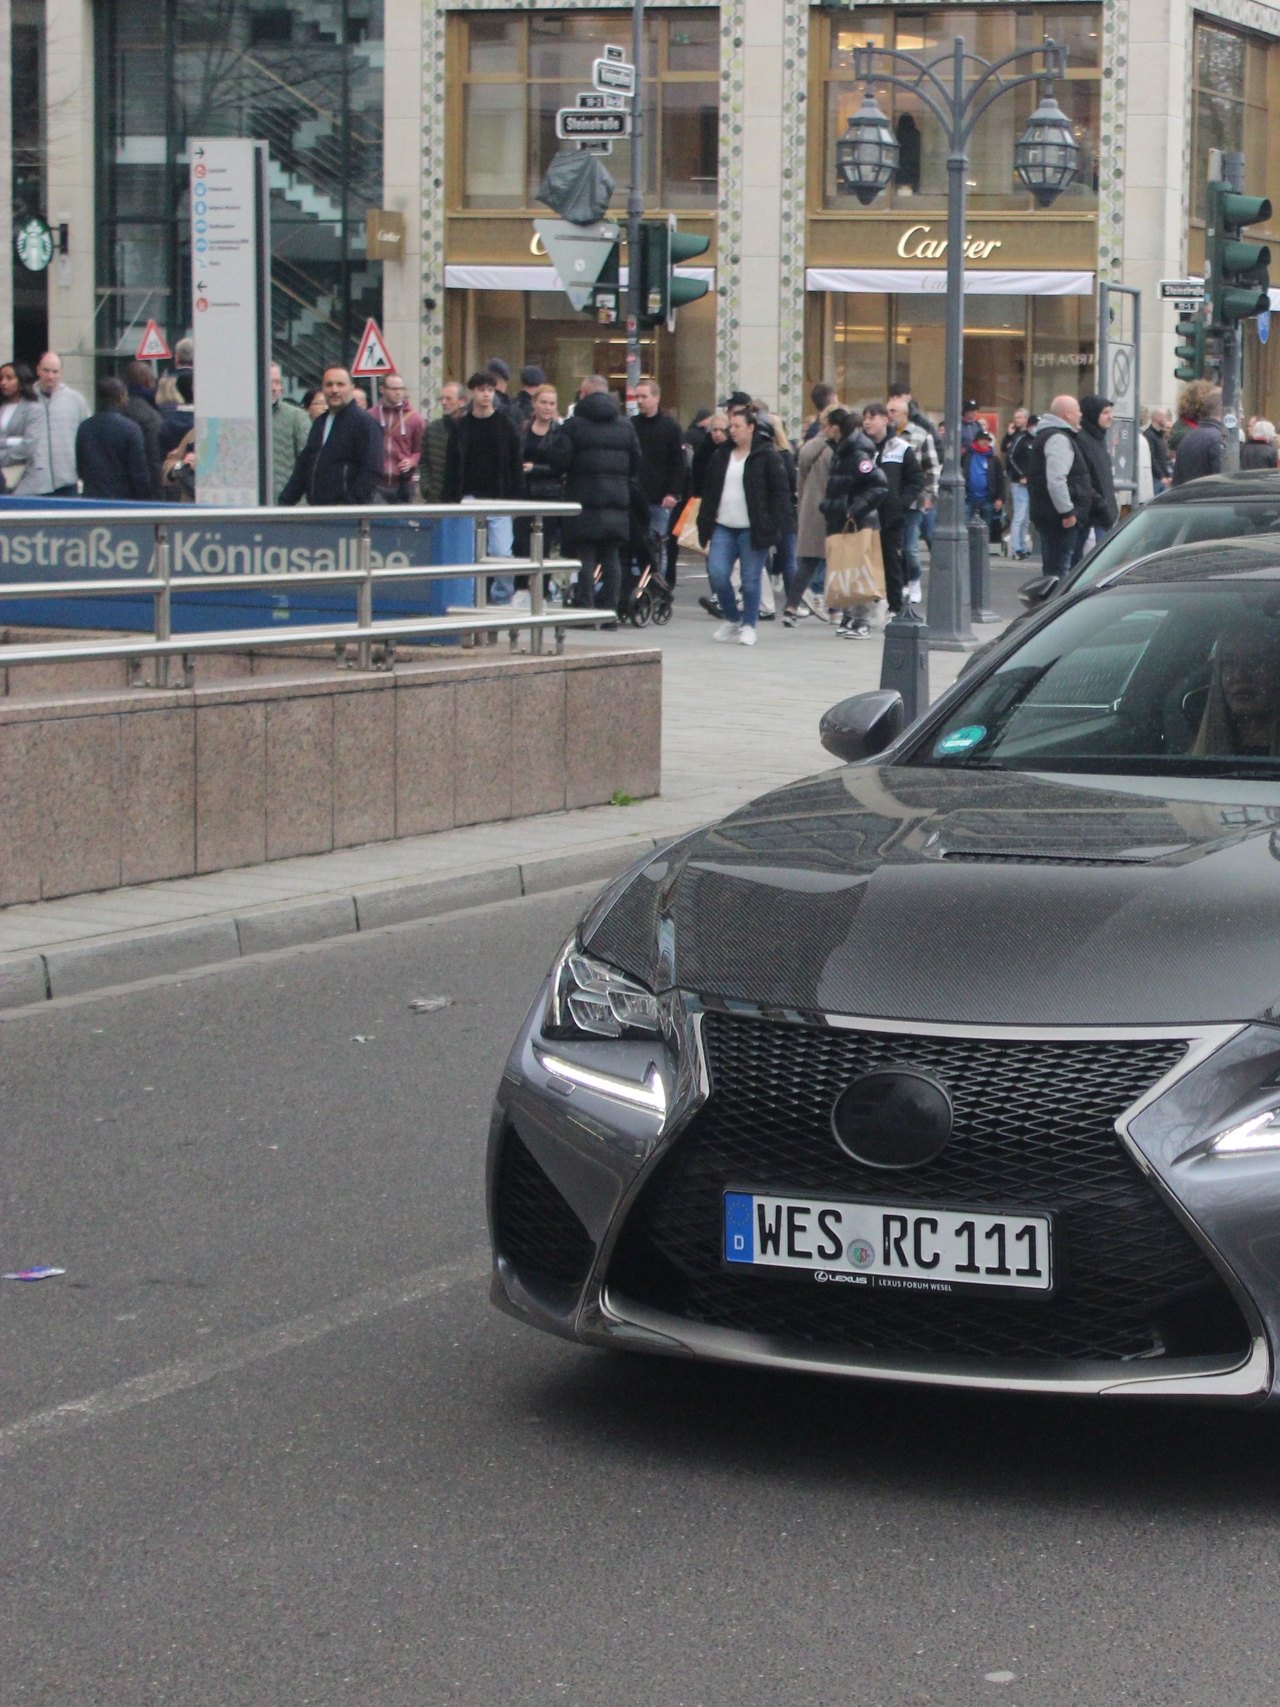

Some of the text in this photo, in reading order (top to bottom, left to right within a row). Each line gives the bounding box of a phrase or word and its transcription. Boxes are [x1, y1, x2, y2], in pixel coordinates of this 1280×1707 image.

[565, 116, 620, 131] Steinstraße
[897, 225, 1002, 259] Carier
[734, 1203, 1043, 1279] D WES RC 111
[829, 1274, 867, 1285] LEXUS
[879, 1279, 952, 1292] LEXUS FORUM WESEL
